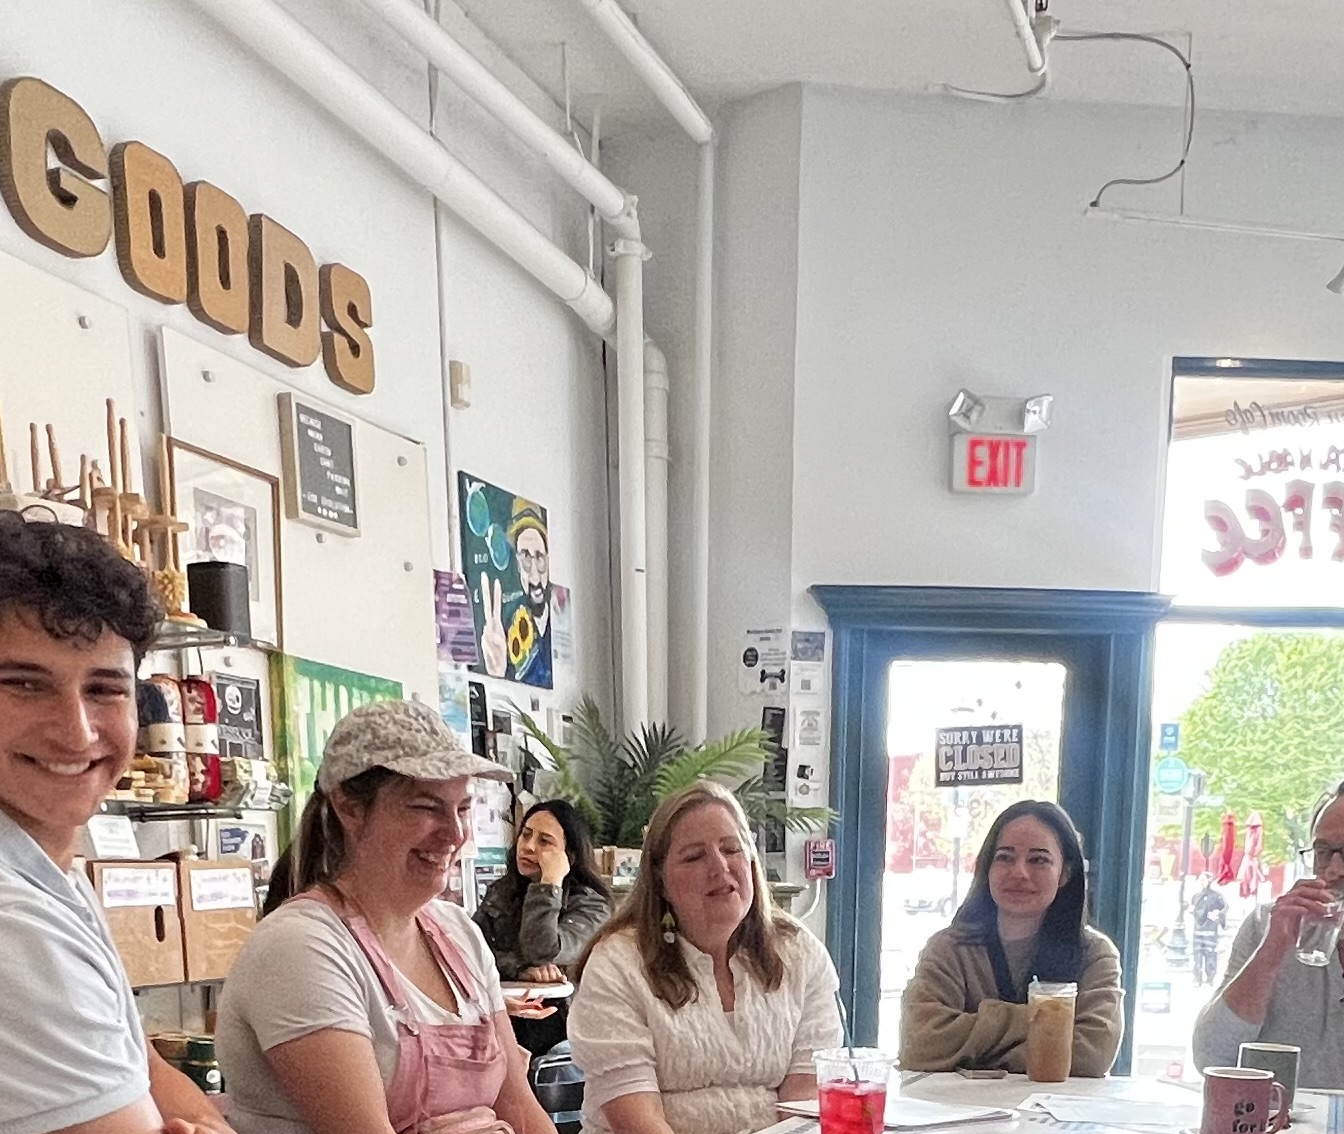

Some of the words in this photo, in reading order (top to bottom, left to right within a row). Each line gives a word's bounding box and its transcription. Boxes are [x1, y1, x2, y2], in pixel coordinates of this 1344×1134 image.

[966, 436, 1027, 489] EXIT
[939, 730, 977, 745] SORRY
[938, 742, 1021, 772] CLOSED
[1233, 1101, 1255, 1116] go
[1232, 1119, 1257, 1134] for
